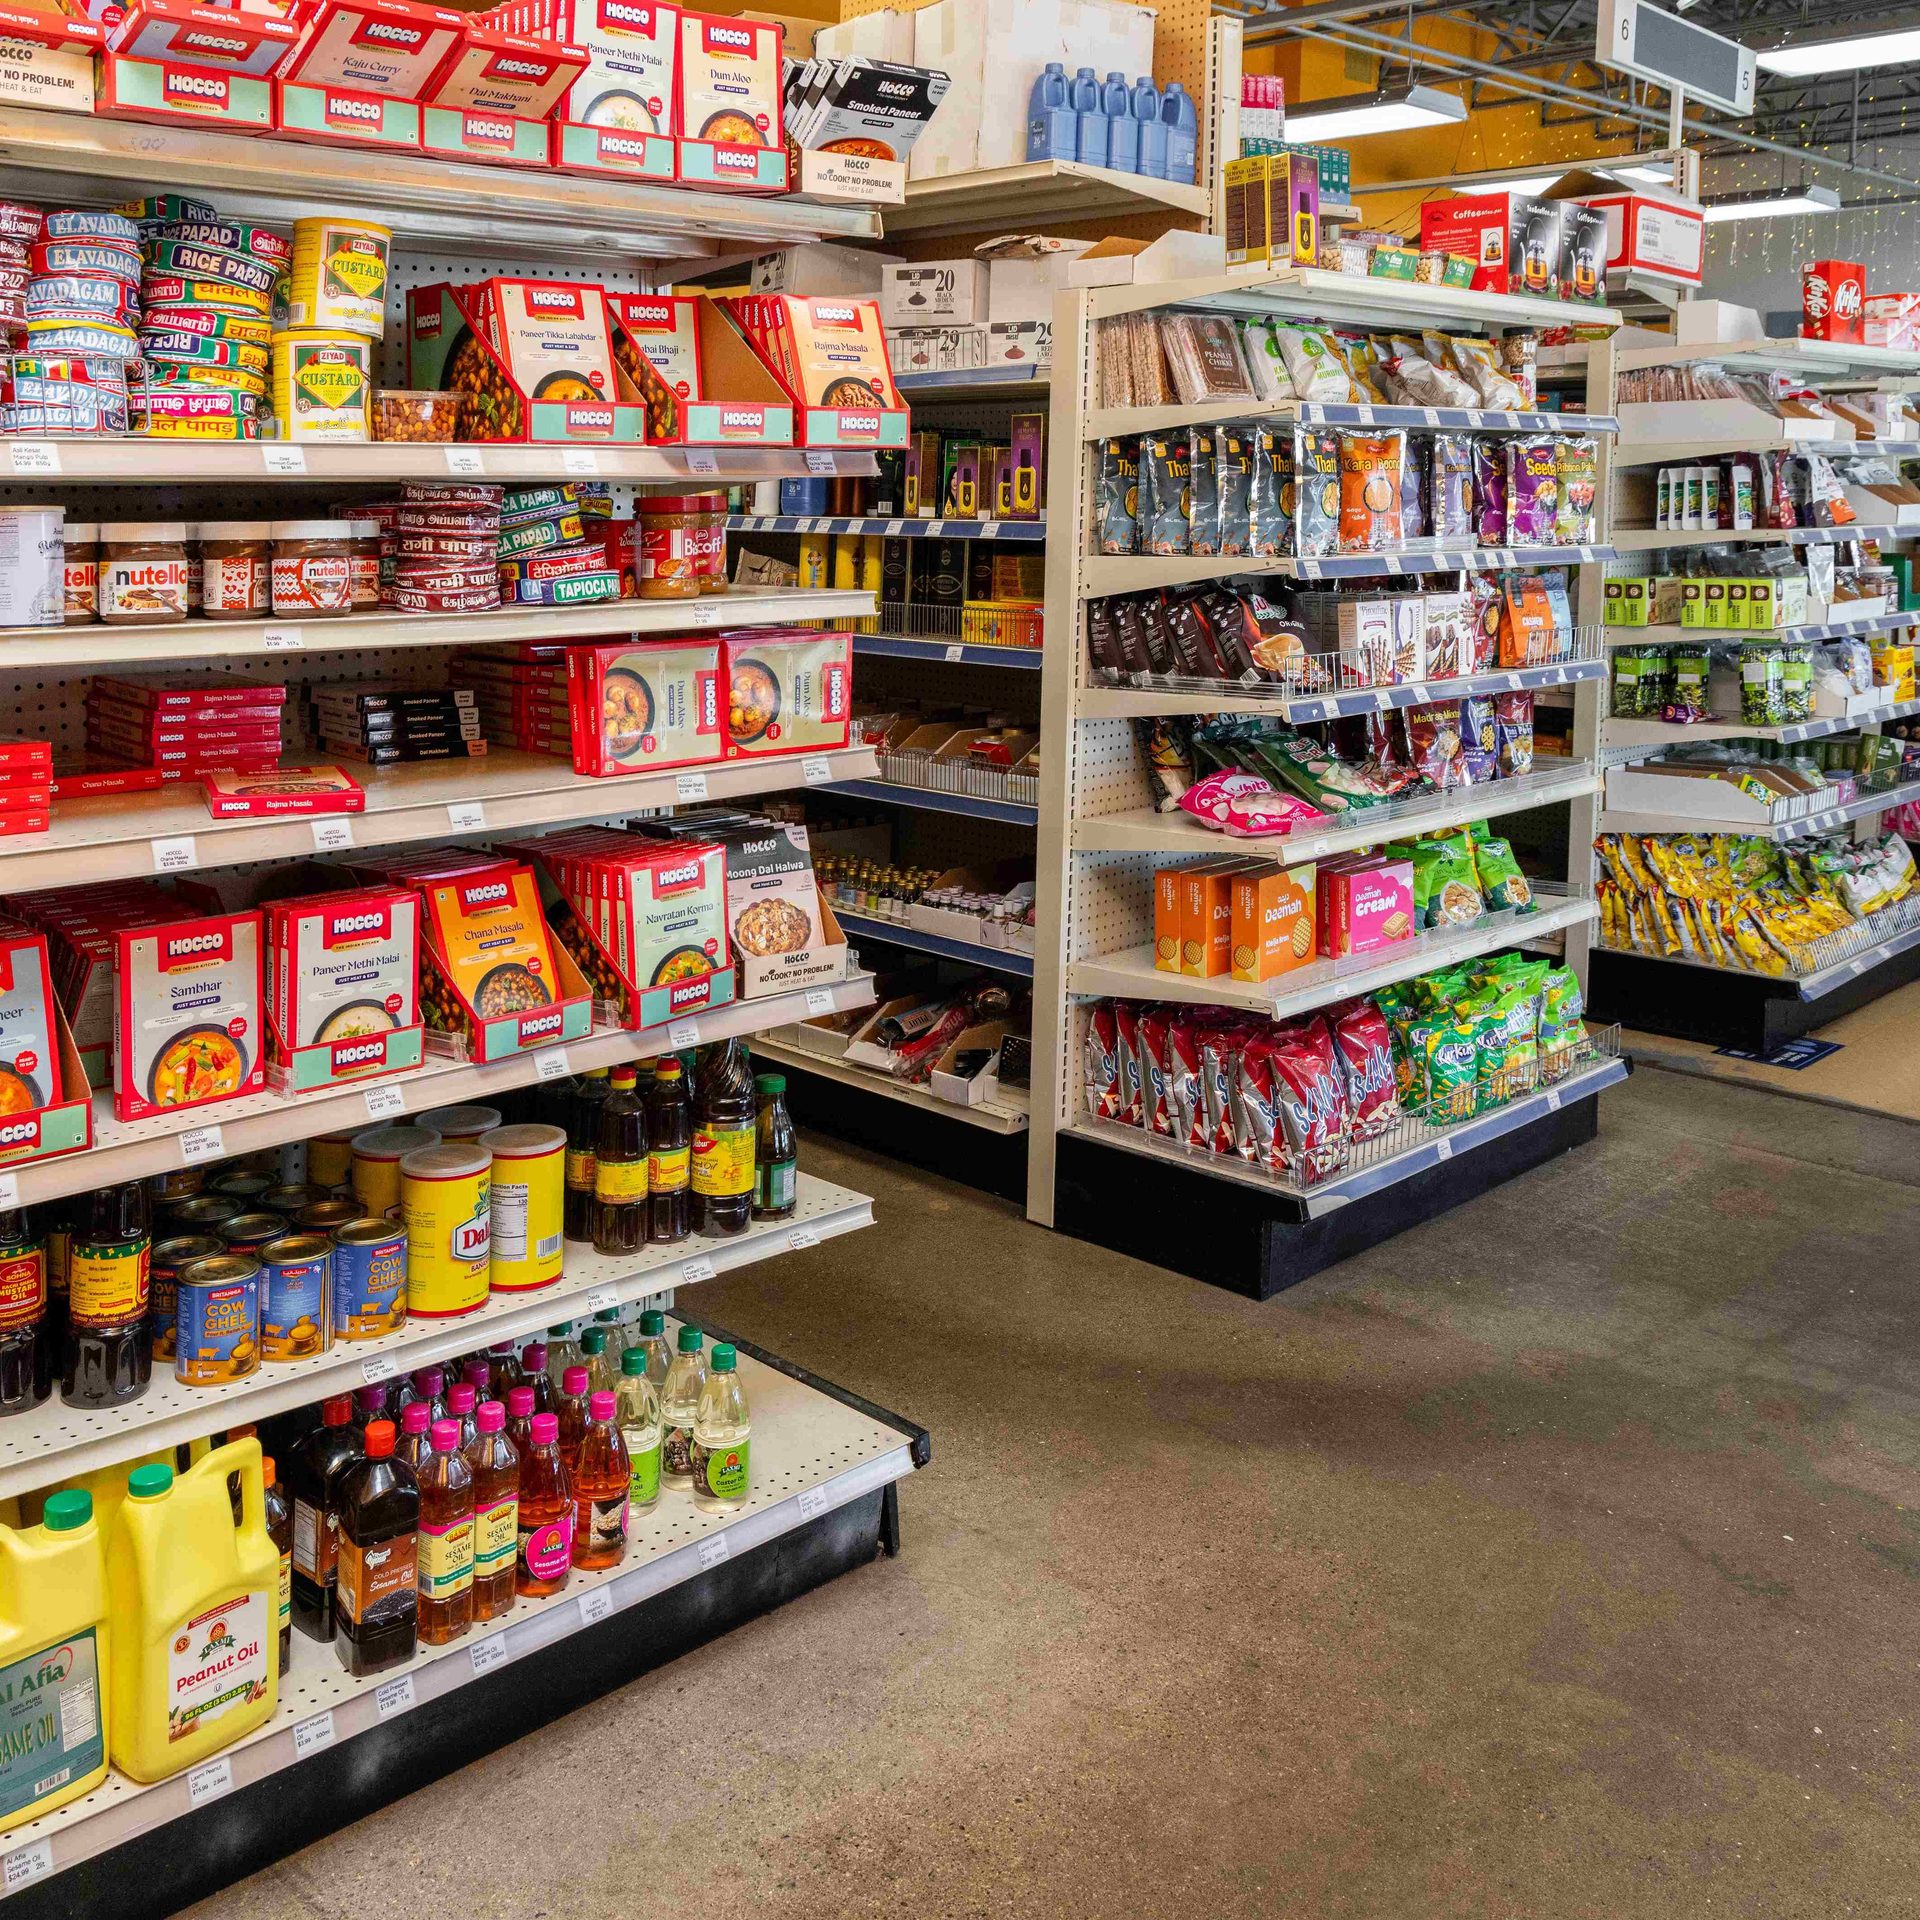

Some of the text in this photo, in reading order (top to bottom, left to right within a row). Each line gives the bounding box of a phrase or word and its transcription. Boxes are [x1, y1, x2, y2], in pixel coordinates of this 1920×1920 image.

[605, 2, 650, 25] HOCCO
[366, 23, 422, 43] HOCCO
[709, 26, 751, 47] HOCCO
[1621, 18, 1629, 40] 6
[186, 32, 248, 51] HOCCO
[587, 40, 663, 67] Paneer Methi Malai
[343, 56, 402, 76] Kaju Curry
[495, 59, 549, 77] HOCCO
[22, 72, 76, 90] PROBLEM!
[710, 68, 752, 85] Dum Aloo
[1742, 70, 1749, 91] 5
[168, 74, 227, 98] HOCCO
[468, 86, 532, 104] Dal Makhani
[328, 98, 381, 120] HOCCO
[847, 100, 922, 119] Smoked Paneer
[466, 119, 514, 140] HOCCO
[601, 135, 644, 156] HOCCO
[716, 150, 757, 169] HOCCO
[180, 225, 232, 245] PAPAD
[353, 240, 375, 251] ZIYAD
[179, 249, 270, 292] RICE PAPAD
[331, 259, 385, 280] CUSTARD
[934, 269, 956, 292] 20
[532, 291, 576, 308] HOCCO
[1834, 284, 1862, 314] KitKat
[628, 305, 669, 322] HOCCO
[815, 307, 855, 322] HOCCO
[519, 329, 597, 342] Paneer Tikka Lababdar
[939, 330, 960, 352] 29
[320, 351, 345, 361] ZIYAD
[658, 344, 680, 356] Bhaji
[813, 341, 869, 354] Rajma Masala
[1203, 350, 1232, 361] PEANUT
[1208, 358, 1233, 368] CHIKKI
[300, 373, 361, 387] CUSTARD
[569, 410, 613, 425] HOCCO
[723, 412, 763, 428] HOCCO
[840, 416, 879, 430] HOCCO
[1343, 459, 1372, 473] Kara
[519, 488, 556, 509] PAPAD
[513, 526, 552, 548] PAPAD
[684, 537, 722, 556] Biscoff
[116, 562, 187, 586] nutella
[308, 563, 346, 577] nutella
[558, 578, 607, 598] TAPIOCA
[166, 693, 244, 705] HOCCO Rajma Masala
[830, 668, 843, 716] HOCCO
[705, 679, 716, 727] HOCCO
[161, 711, 239, 723] HOCCO Masala
[1413, 711, 1443, 724] Madras
[160, 730, 237, 742] HOCCO Rajma Masala
[162, 751, 187, 760] HOCCO
[81, 778, 125, 789] Chana Masala
[221, 799, 313, 811] HOCCO Rajma Masala
[743, 837, 778, 854] HOCCO
[658, 863, 700, 888] HOCCO
[759, 859, 804, 877] Dal Halwa
[465, 883, 508, 903] HOCCO
[1355, 888, 1382, 903] Deemah
[645, 902, 714, 926] Navratan Korma
[1264, 900, 1302, 923] Deemah
[331, 913, 384, 934] HOCCO
[463, 921, 526, 942] Chana Masala
[168, 933, 224, 956] HOCCO
[312, 952, 401, 977] Paneer Methi Malai
[769, 963, 834, 982] COOK? PROBLEM!
[170, 979, 223, 999] Sambhar
[673, 982, 709, 1003] HOCCO
[521, 1014, 562, 1036] HOCCO
[333, 1042, 384, 1065] HOCCO
[367, 1088, 386, 1097] HOCCO
[370, 1102, 384, 1111] $2.49
[182, 1130, 204, 1139] HOCCO
[183, 1136, 209, 1146] Sambhar
[184, 1141, 220, 1154] $2.49 300g
[0, 1281, 37, 1297] MUSTARD
[10, 1292, 28, 1301] OIL
[211, 1288, 242, 1299] BRITANNIA
[206, 1300, 246, 1317] COW
[204, 1312, 247, 1330] GHEE
[363, 1359, 383, 1369] Britannia
[722, 1463, 741, 1475] LAXMI
[715, 1477, 736, 1487] Castor
[486, 1522, 514, 1539] SESAME
[493, 1533, 506, 1543] OIL
[444, 1542, 472, 1560] SESAME
[451, 1553, 464, 1564] OIL
[534, 1554, 568, 1569] Sesame Oil
[373, 1562, 414, 1580] COLD PRESSED
[369, 1568, 414, 1593] Sesame Oil
[202, 1636, 234, 1658] LAXMI
[472, 1645, 498, 1662] Sesame Oil
[490, 1651, 505, 1662] 500ml
[176, 1642, 260, 1693] Peanut Oil
[20, 1662, 66, 1697] Afia
[377, 1680, 409, 1697] Cold Pressed
[378, 1688, 406, 1704] Sesame Oil
[37, 1712, 59, 1749] OIL
[295, 1715, 329, 1734] Bansi Mustard
[296, 1733, 304, 1741] Oil
[315, 1728, 331, 1740] 500ml
[190, 1764, 223, 1783] Laxmi Peanut
[6, 1852, 27, 1866] Al Afia
[7, 1854, 41, 1875] Sesame Oil
[8, 1868, 30, 1884] $24.99
